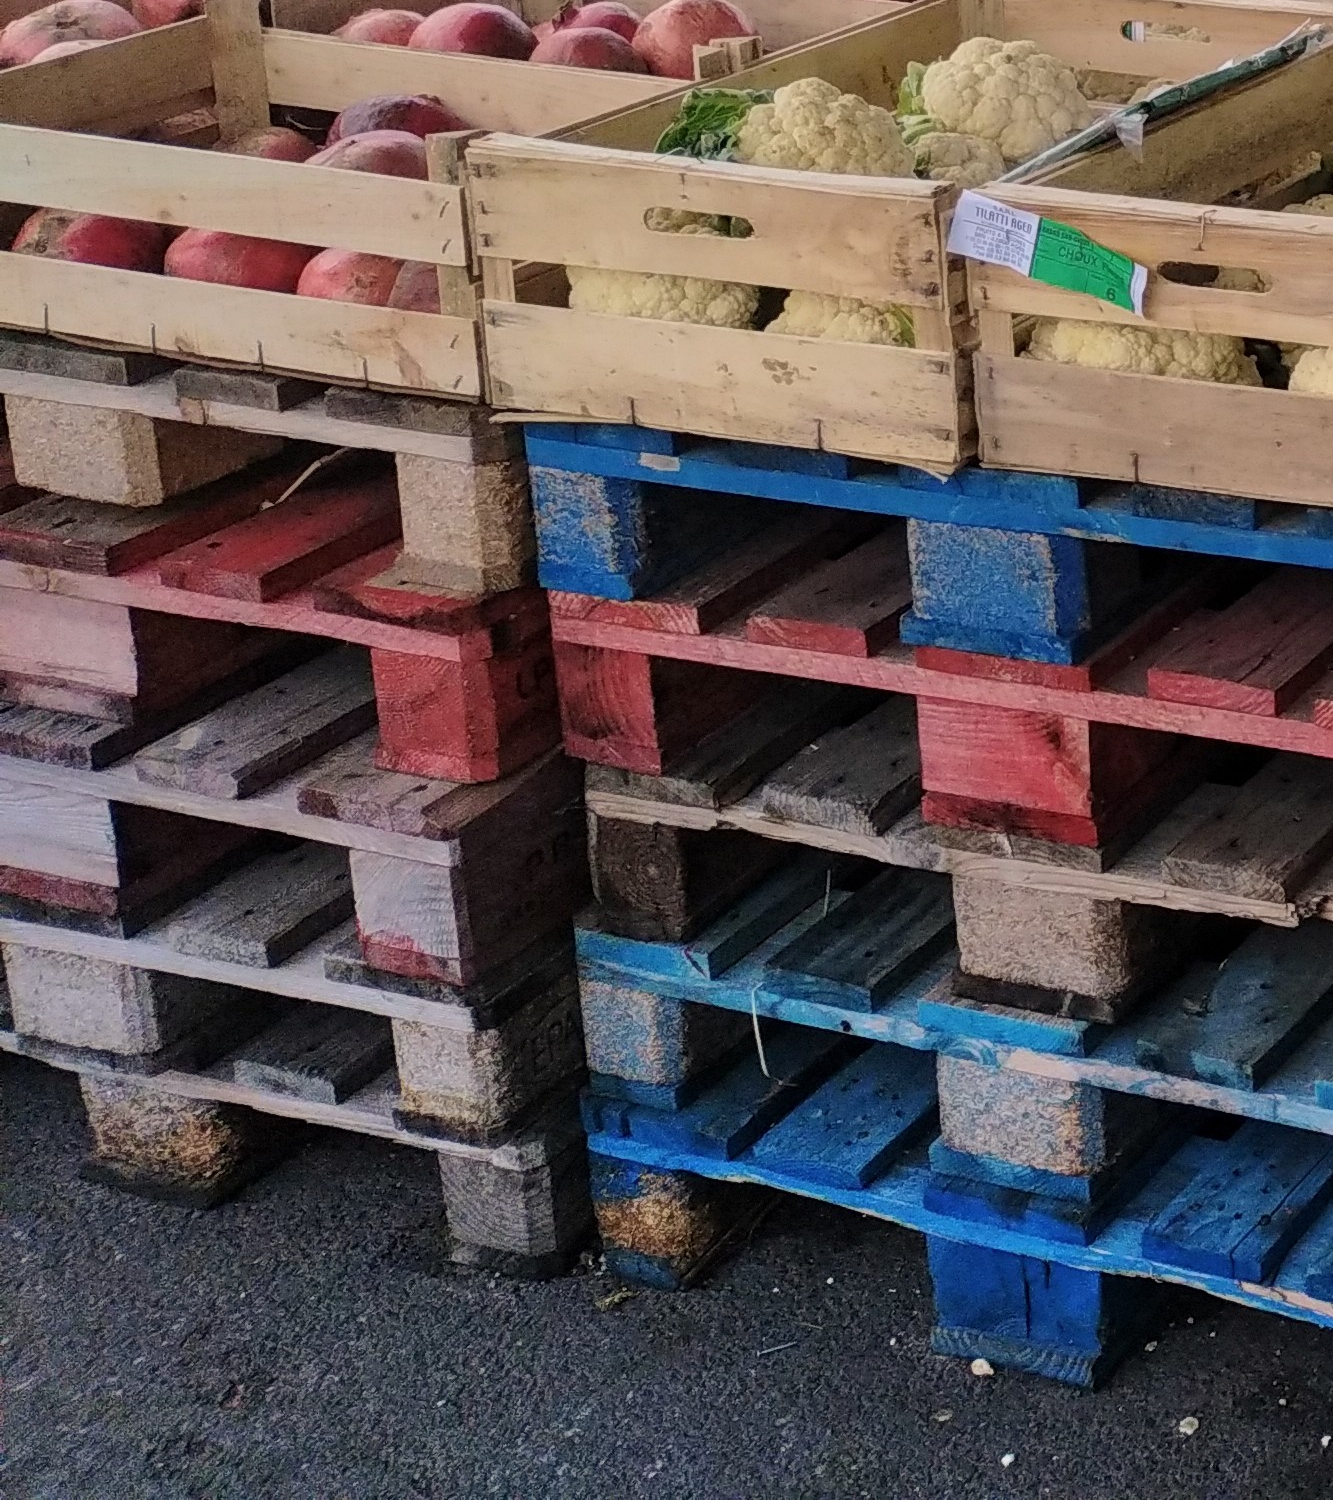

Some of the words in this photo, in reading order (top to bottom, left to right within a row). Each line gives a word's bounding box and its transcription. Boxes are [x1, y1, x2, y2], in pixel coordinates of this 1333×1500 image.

[975, 206, 1009, 227] TILATTI
[1011, 218, 1034, 235] AGEN
[1059, 246, 1099, 267] CHOUX
[1106, 287, 1117, 301] 6
